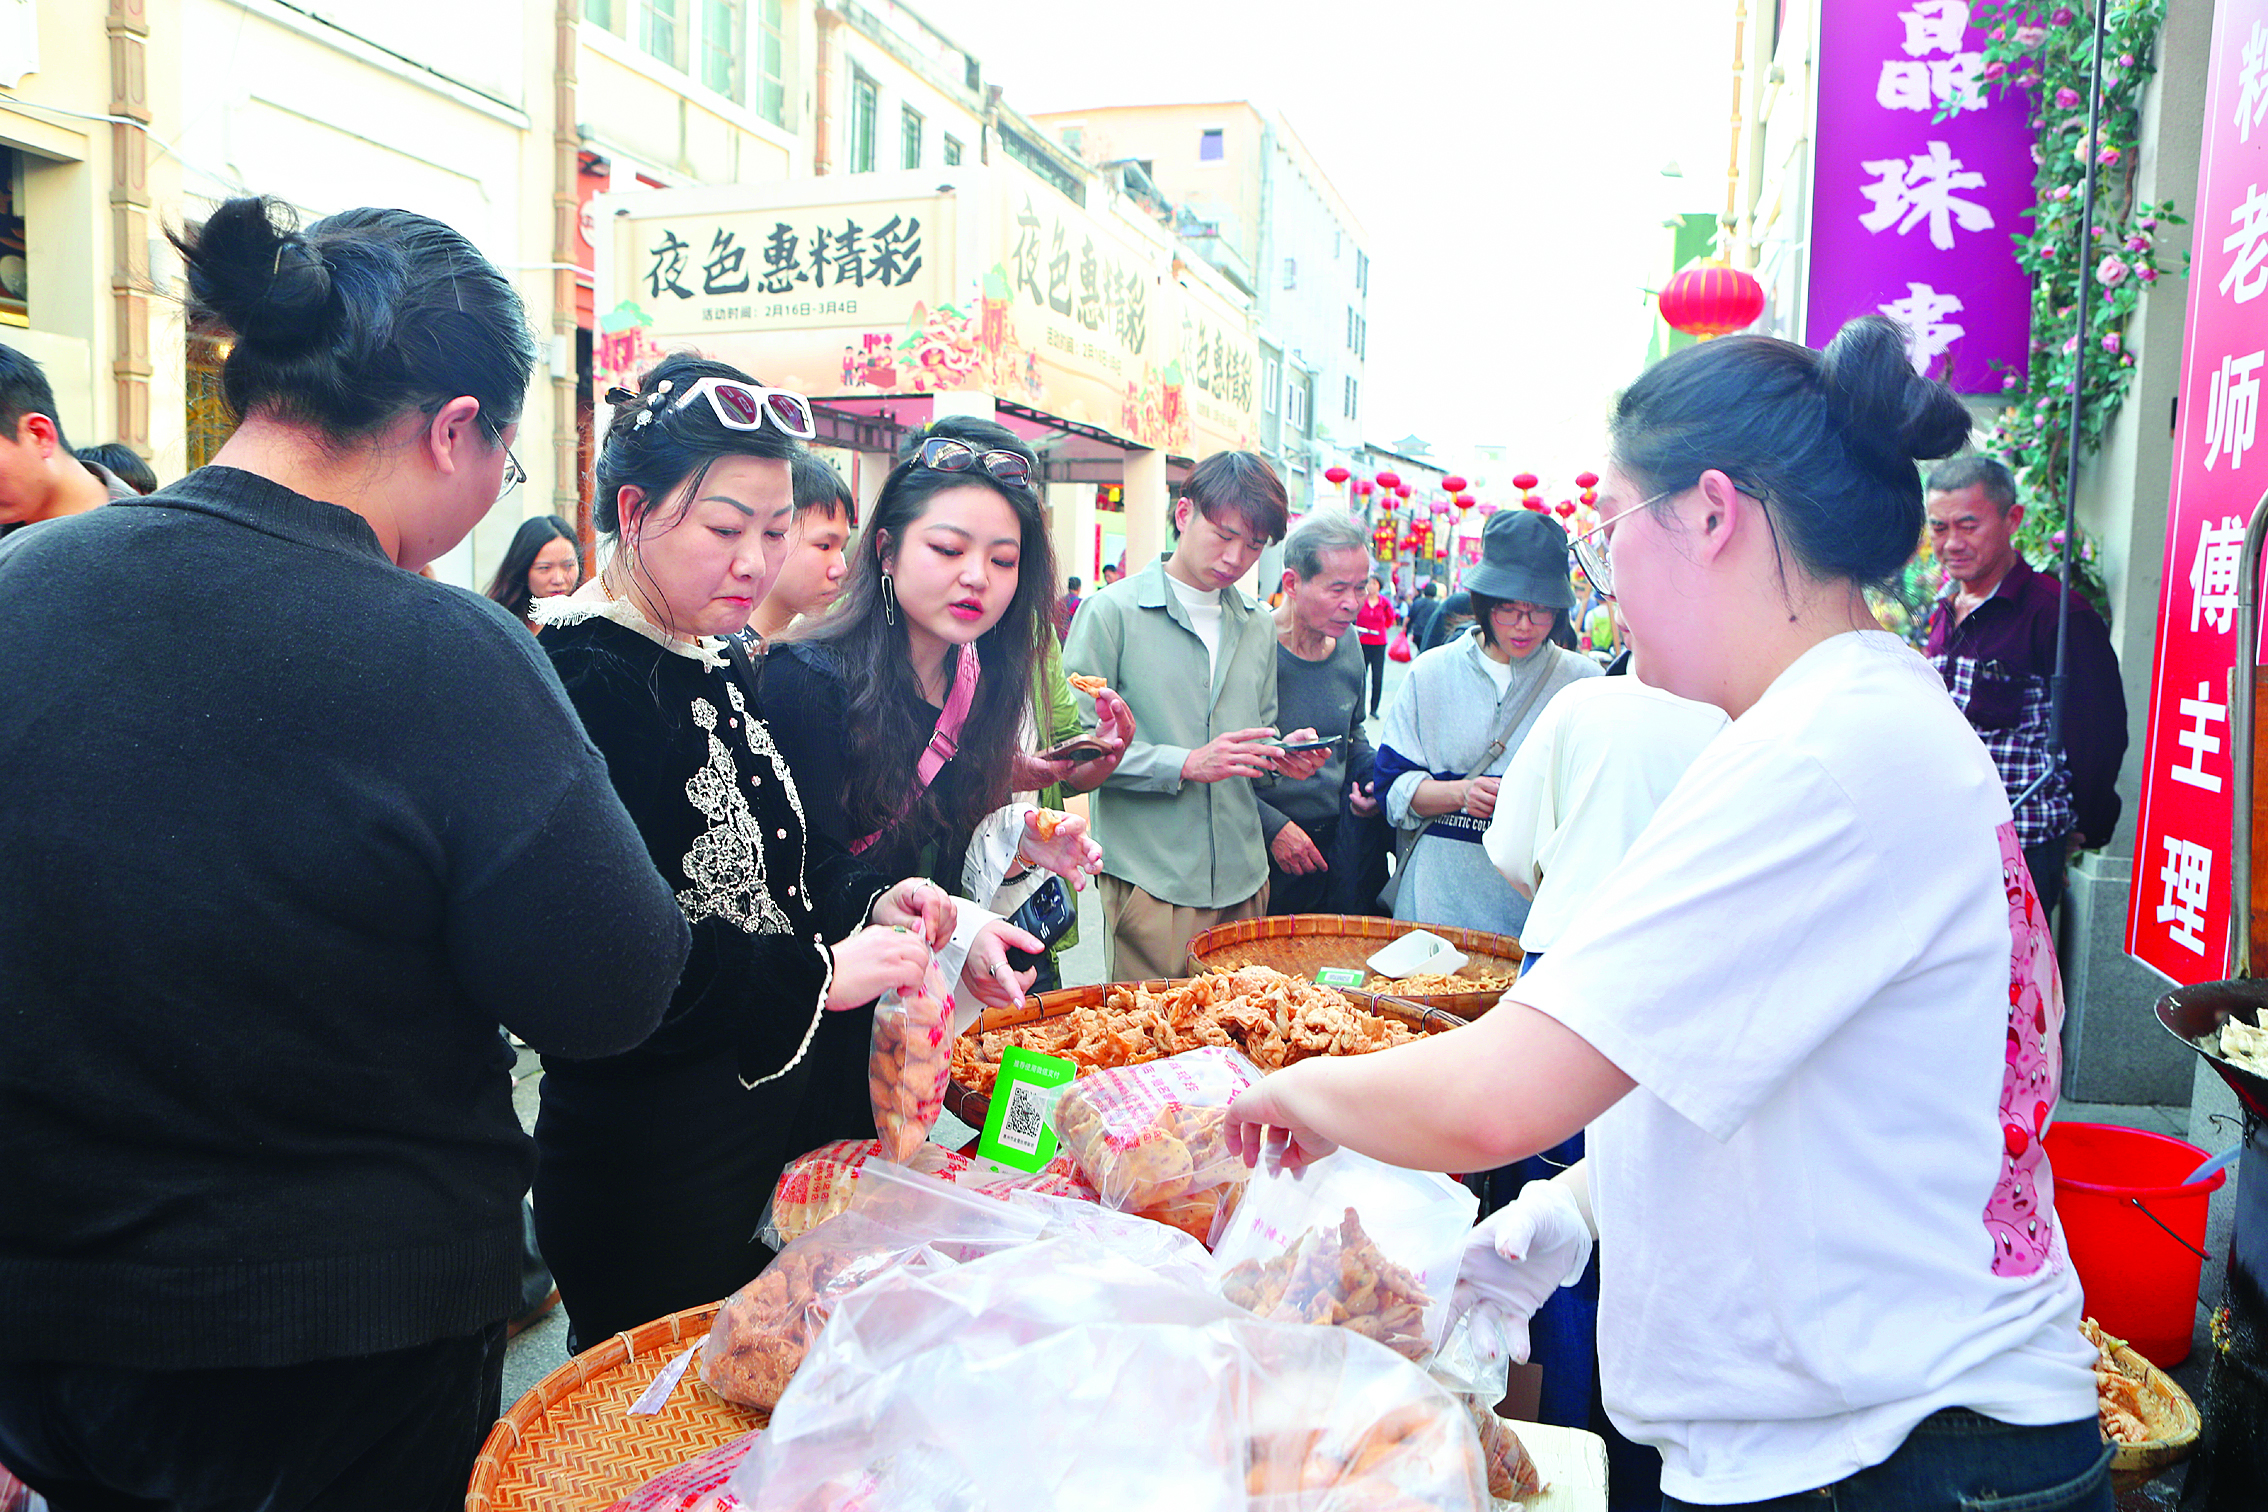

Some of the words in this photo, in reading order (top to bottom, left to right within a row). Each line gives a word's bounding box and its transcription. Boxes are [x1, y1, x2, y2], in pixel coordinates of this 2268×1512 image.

[642, 214, 922, 299] 夜色惠精彩
[1012, 190, 1146, 355] 夜色惠精彩
